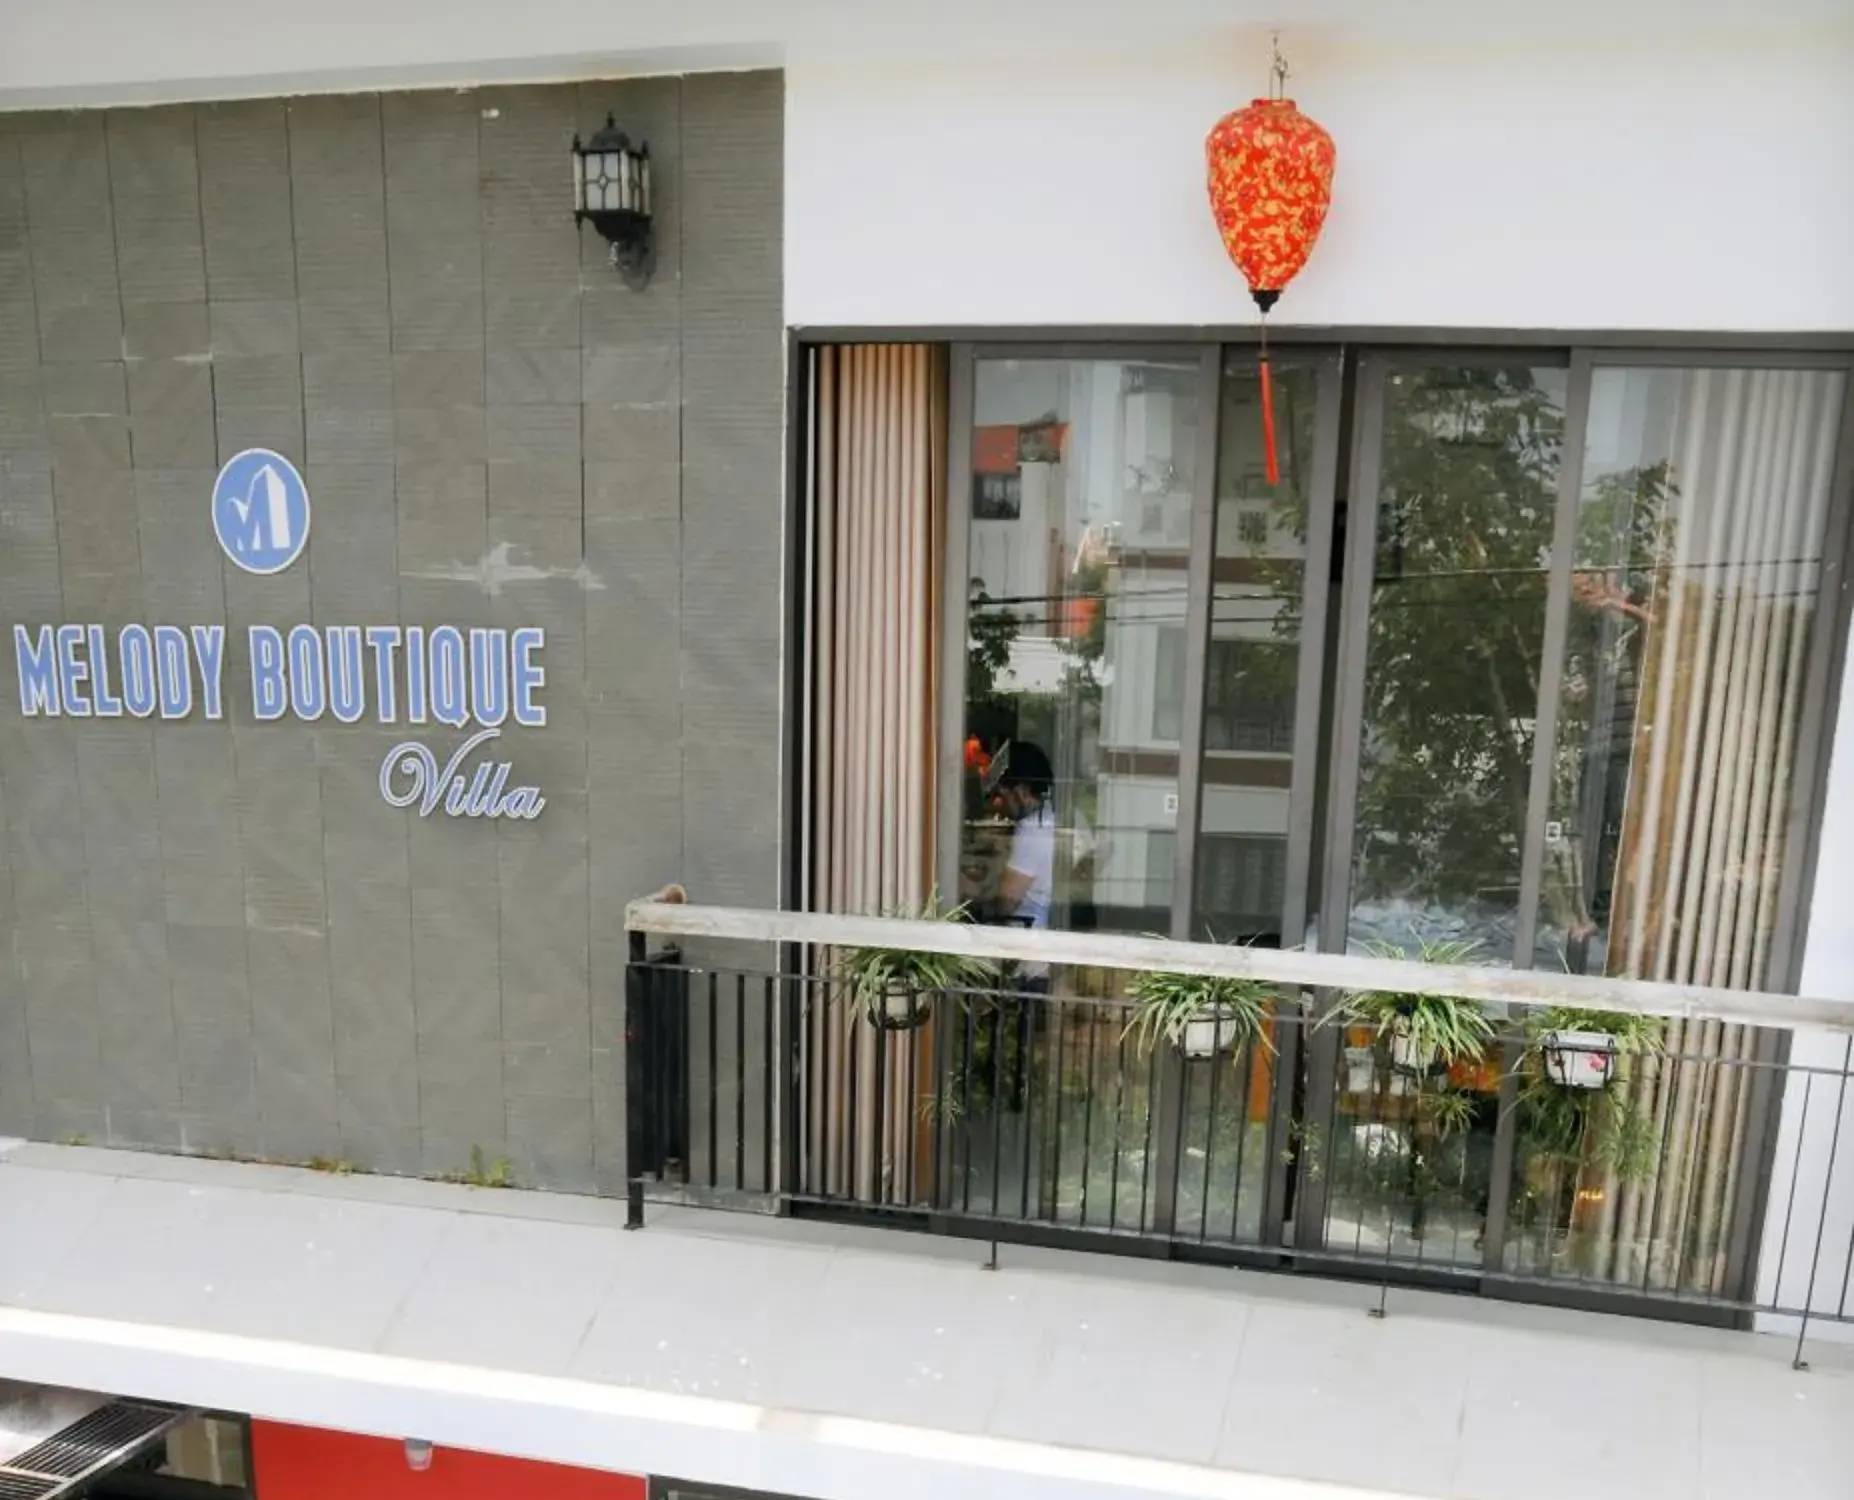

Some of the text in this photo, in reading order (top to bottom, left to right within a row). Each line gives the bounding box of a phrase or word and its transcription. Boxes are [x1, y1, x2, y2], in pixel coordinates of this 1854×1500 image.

[13, 624, 547, 728] MELODY BOUTIQUE
[379, 728, 546, 819] Villa
